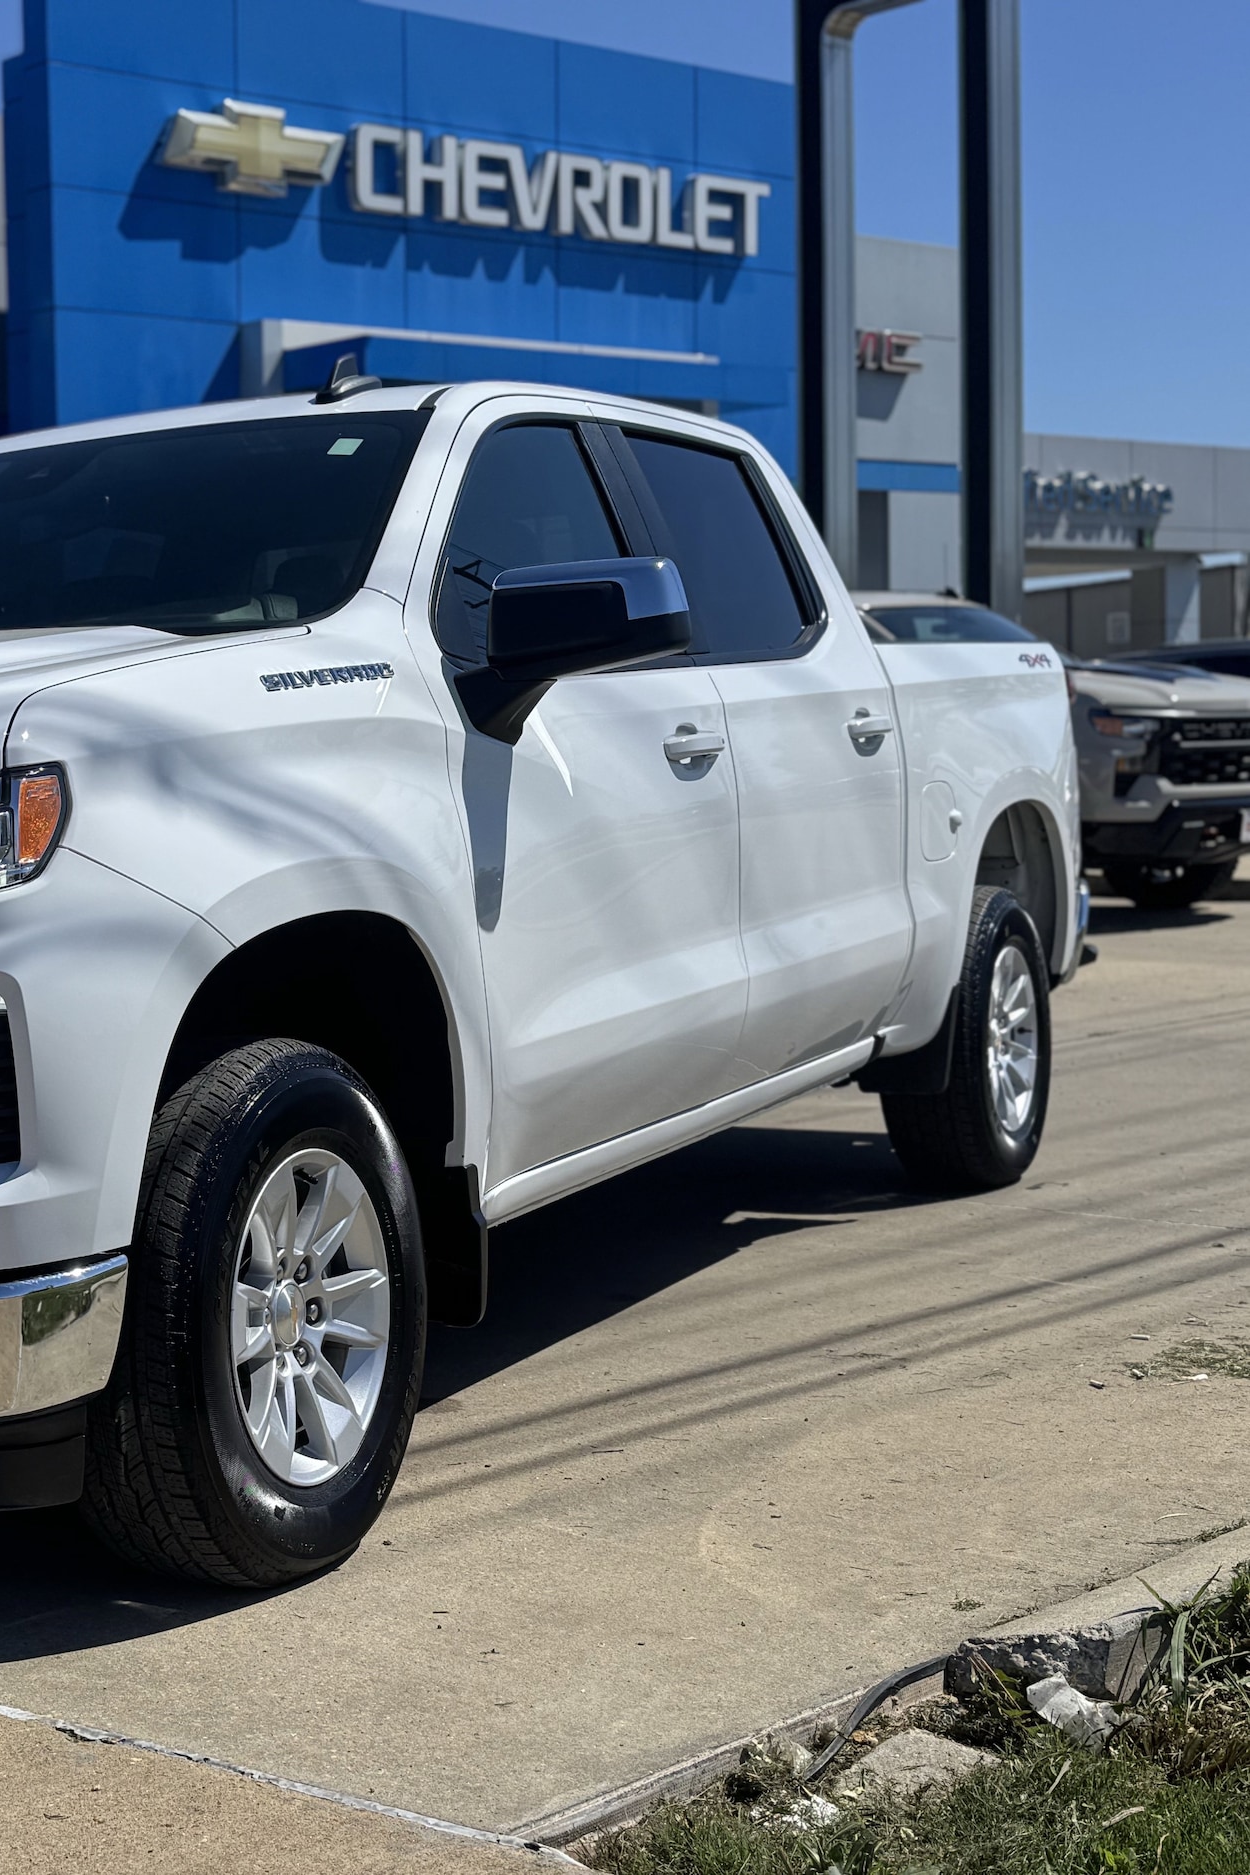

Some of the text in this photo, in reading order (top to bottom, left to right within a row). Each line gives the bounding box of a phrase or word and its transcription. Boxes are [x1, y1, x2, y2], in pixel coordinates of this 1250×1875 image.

[353, 123, 771, 256] CHEVROLET
[259, 661, 395, 692] SILVERADO
[214, 1140, 270, 1325] GENERAL
